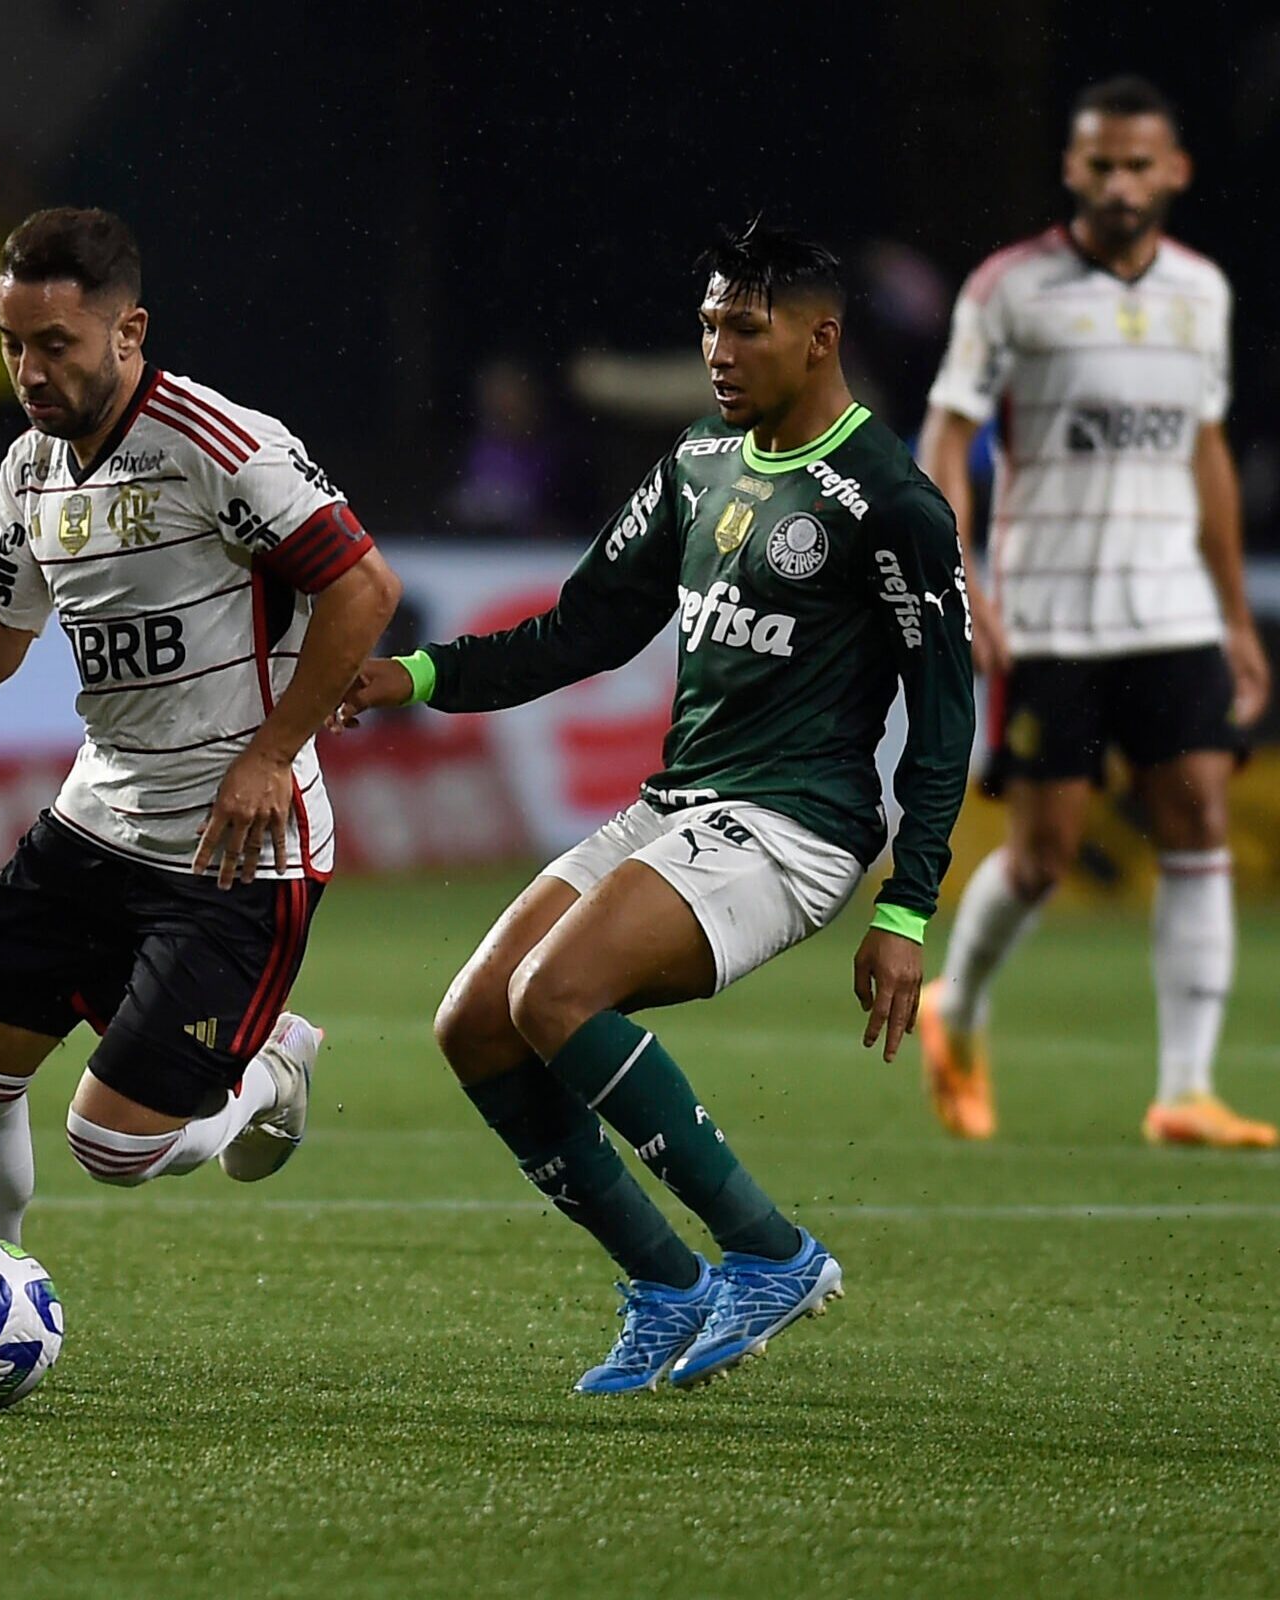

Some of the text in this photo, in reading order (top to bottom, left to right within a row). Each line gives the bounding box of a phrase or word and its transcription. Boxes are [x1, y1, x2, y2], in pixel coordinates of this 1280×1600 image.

[109, 449, 166, 477] pixbet
[675, 436, 744, 460] Fam
[604, 468, 664, 562] crefisa
[806, 460, 870, 521] crefisa
[771, 532, 823, 575] PALMEIRAS
[875, 549, 922, 649] crefisa
[78, 614, 186, 685] BRB
